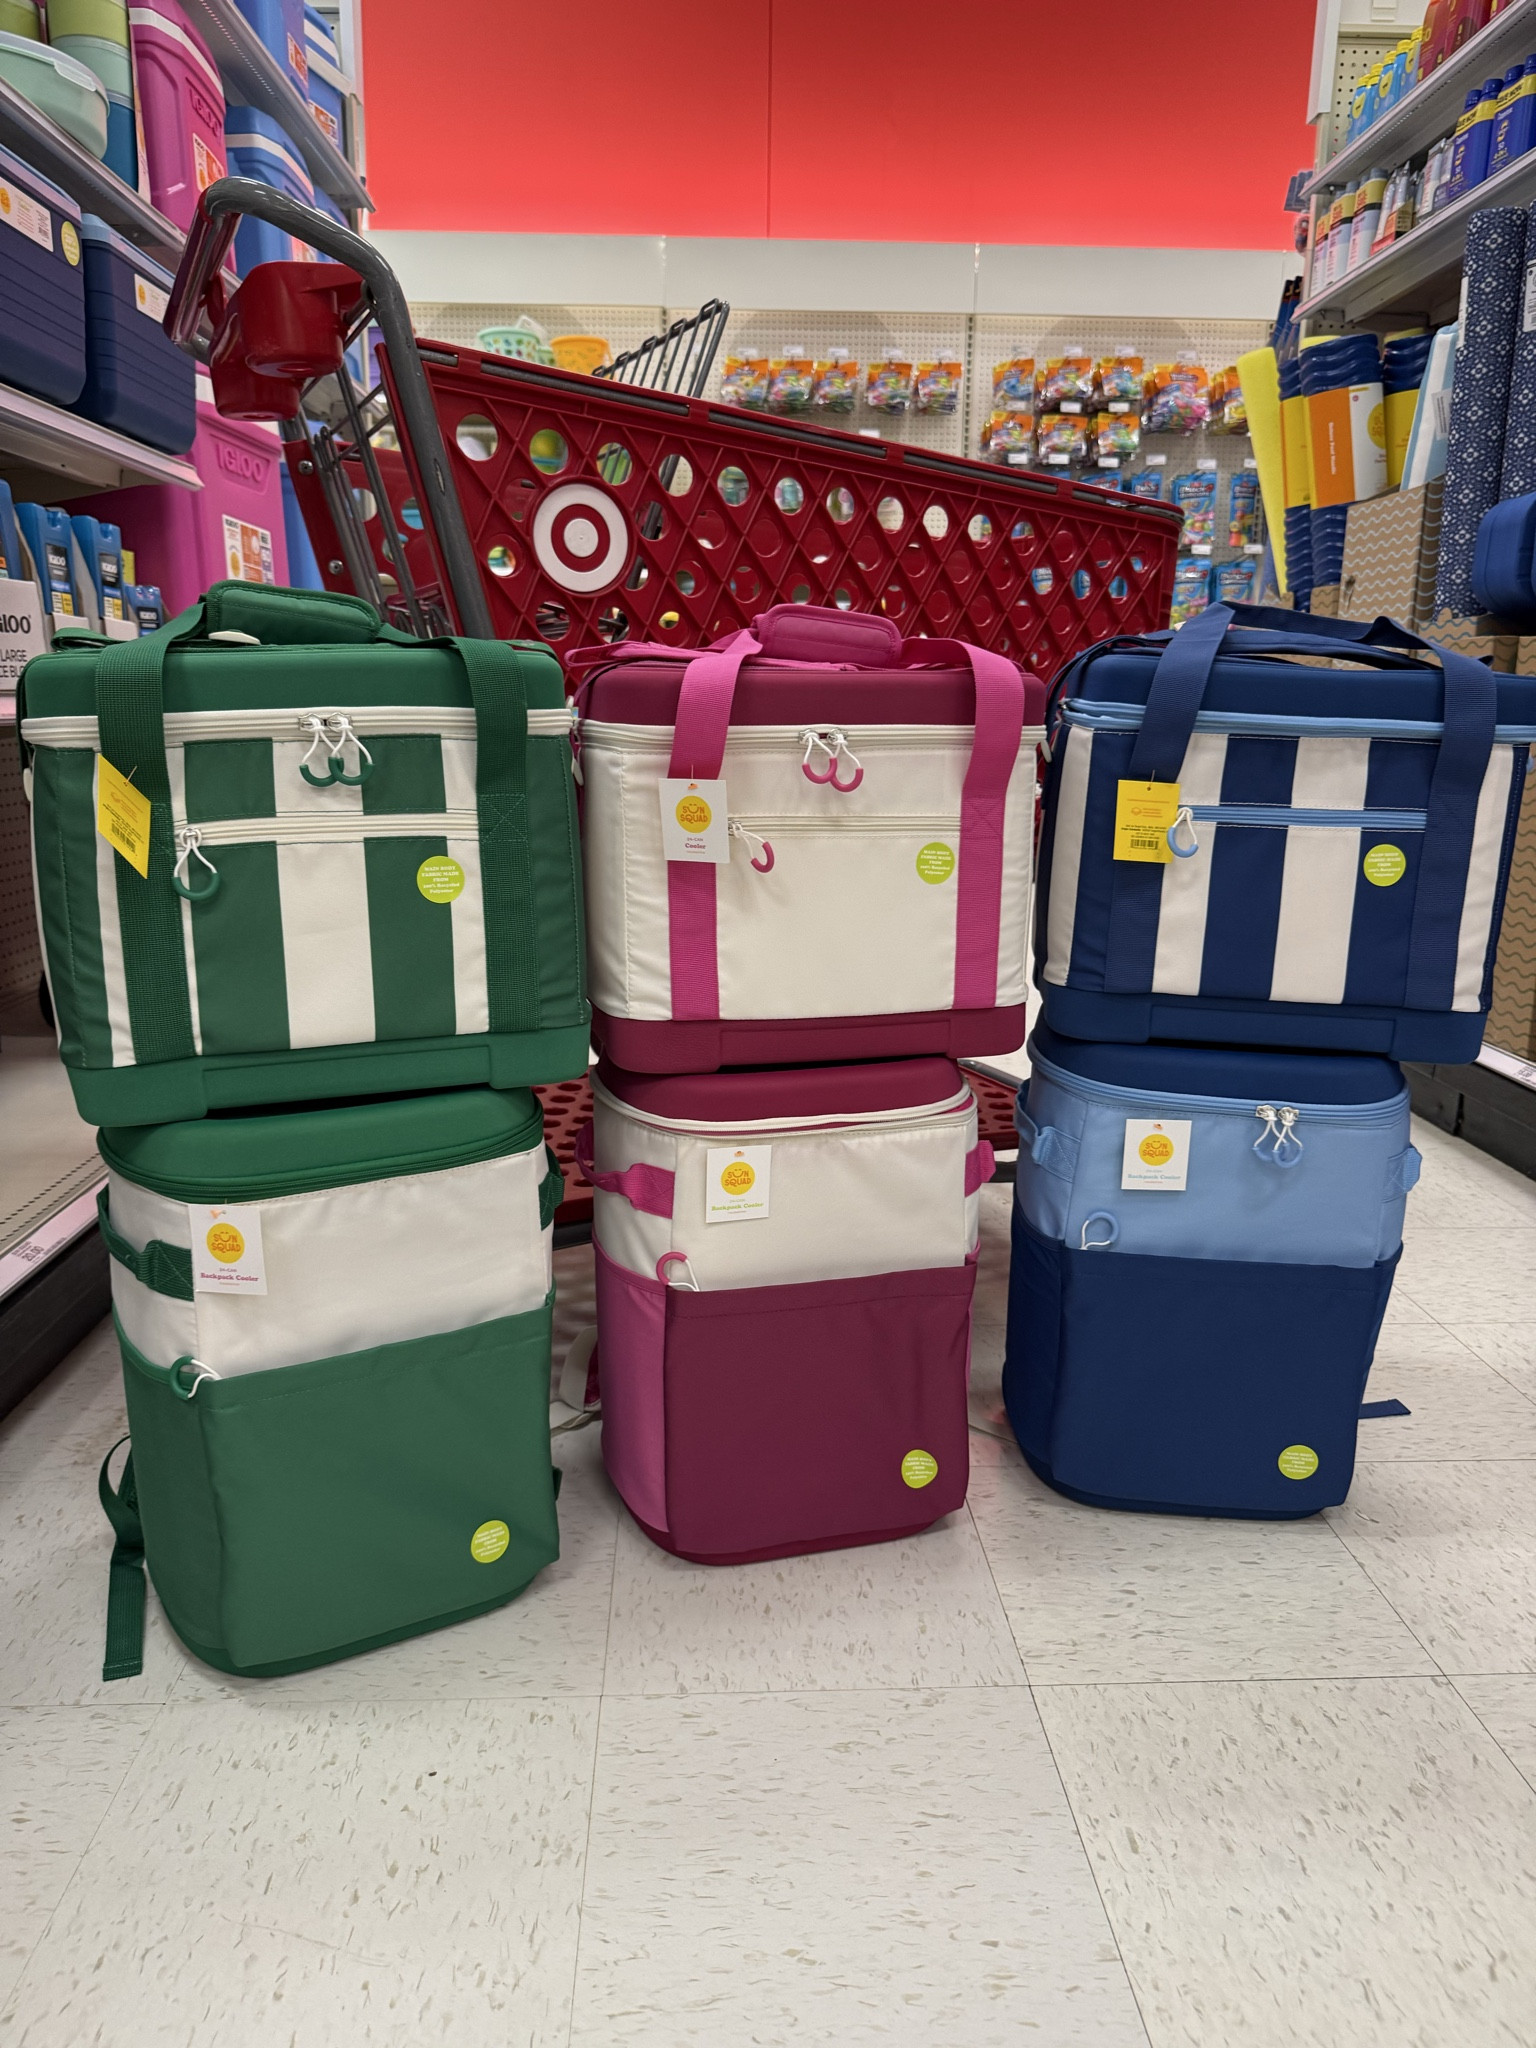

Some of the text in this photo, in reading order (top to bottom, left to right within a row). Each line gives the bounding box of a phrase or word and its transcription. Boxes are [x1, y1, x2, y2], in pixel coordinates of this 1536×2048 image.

[216, 443, 264, 483] IGLOO
[682, 804, 704, 814] SUN
[680, 814, 708, 824] SQUAD
[1143, 1150, 1170, 1158] SQUAD
[728, 1170, 749, 1178] SUN
[725, 1178, 752, 1187] SQUAD
[213, 1233, 237, 1242] SUN
[211, 1243, 241, 1253] SQUAD
